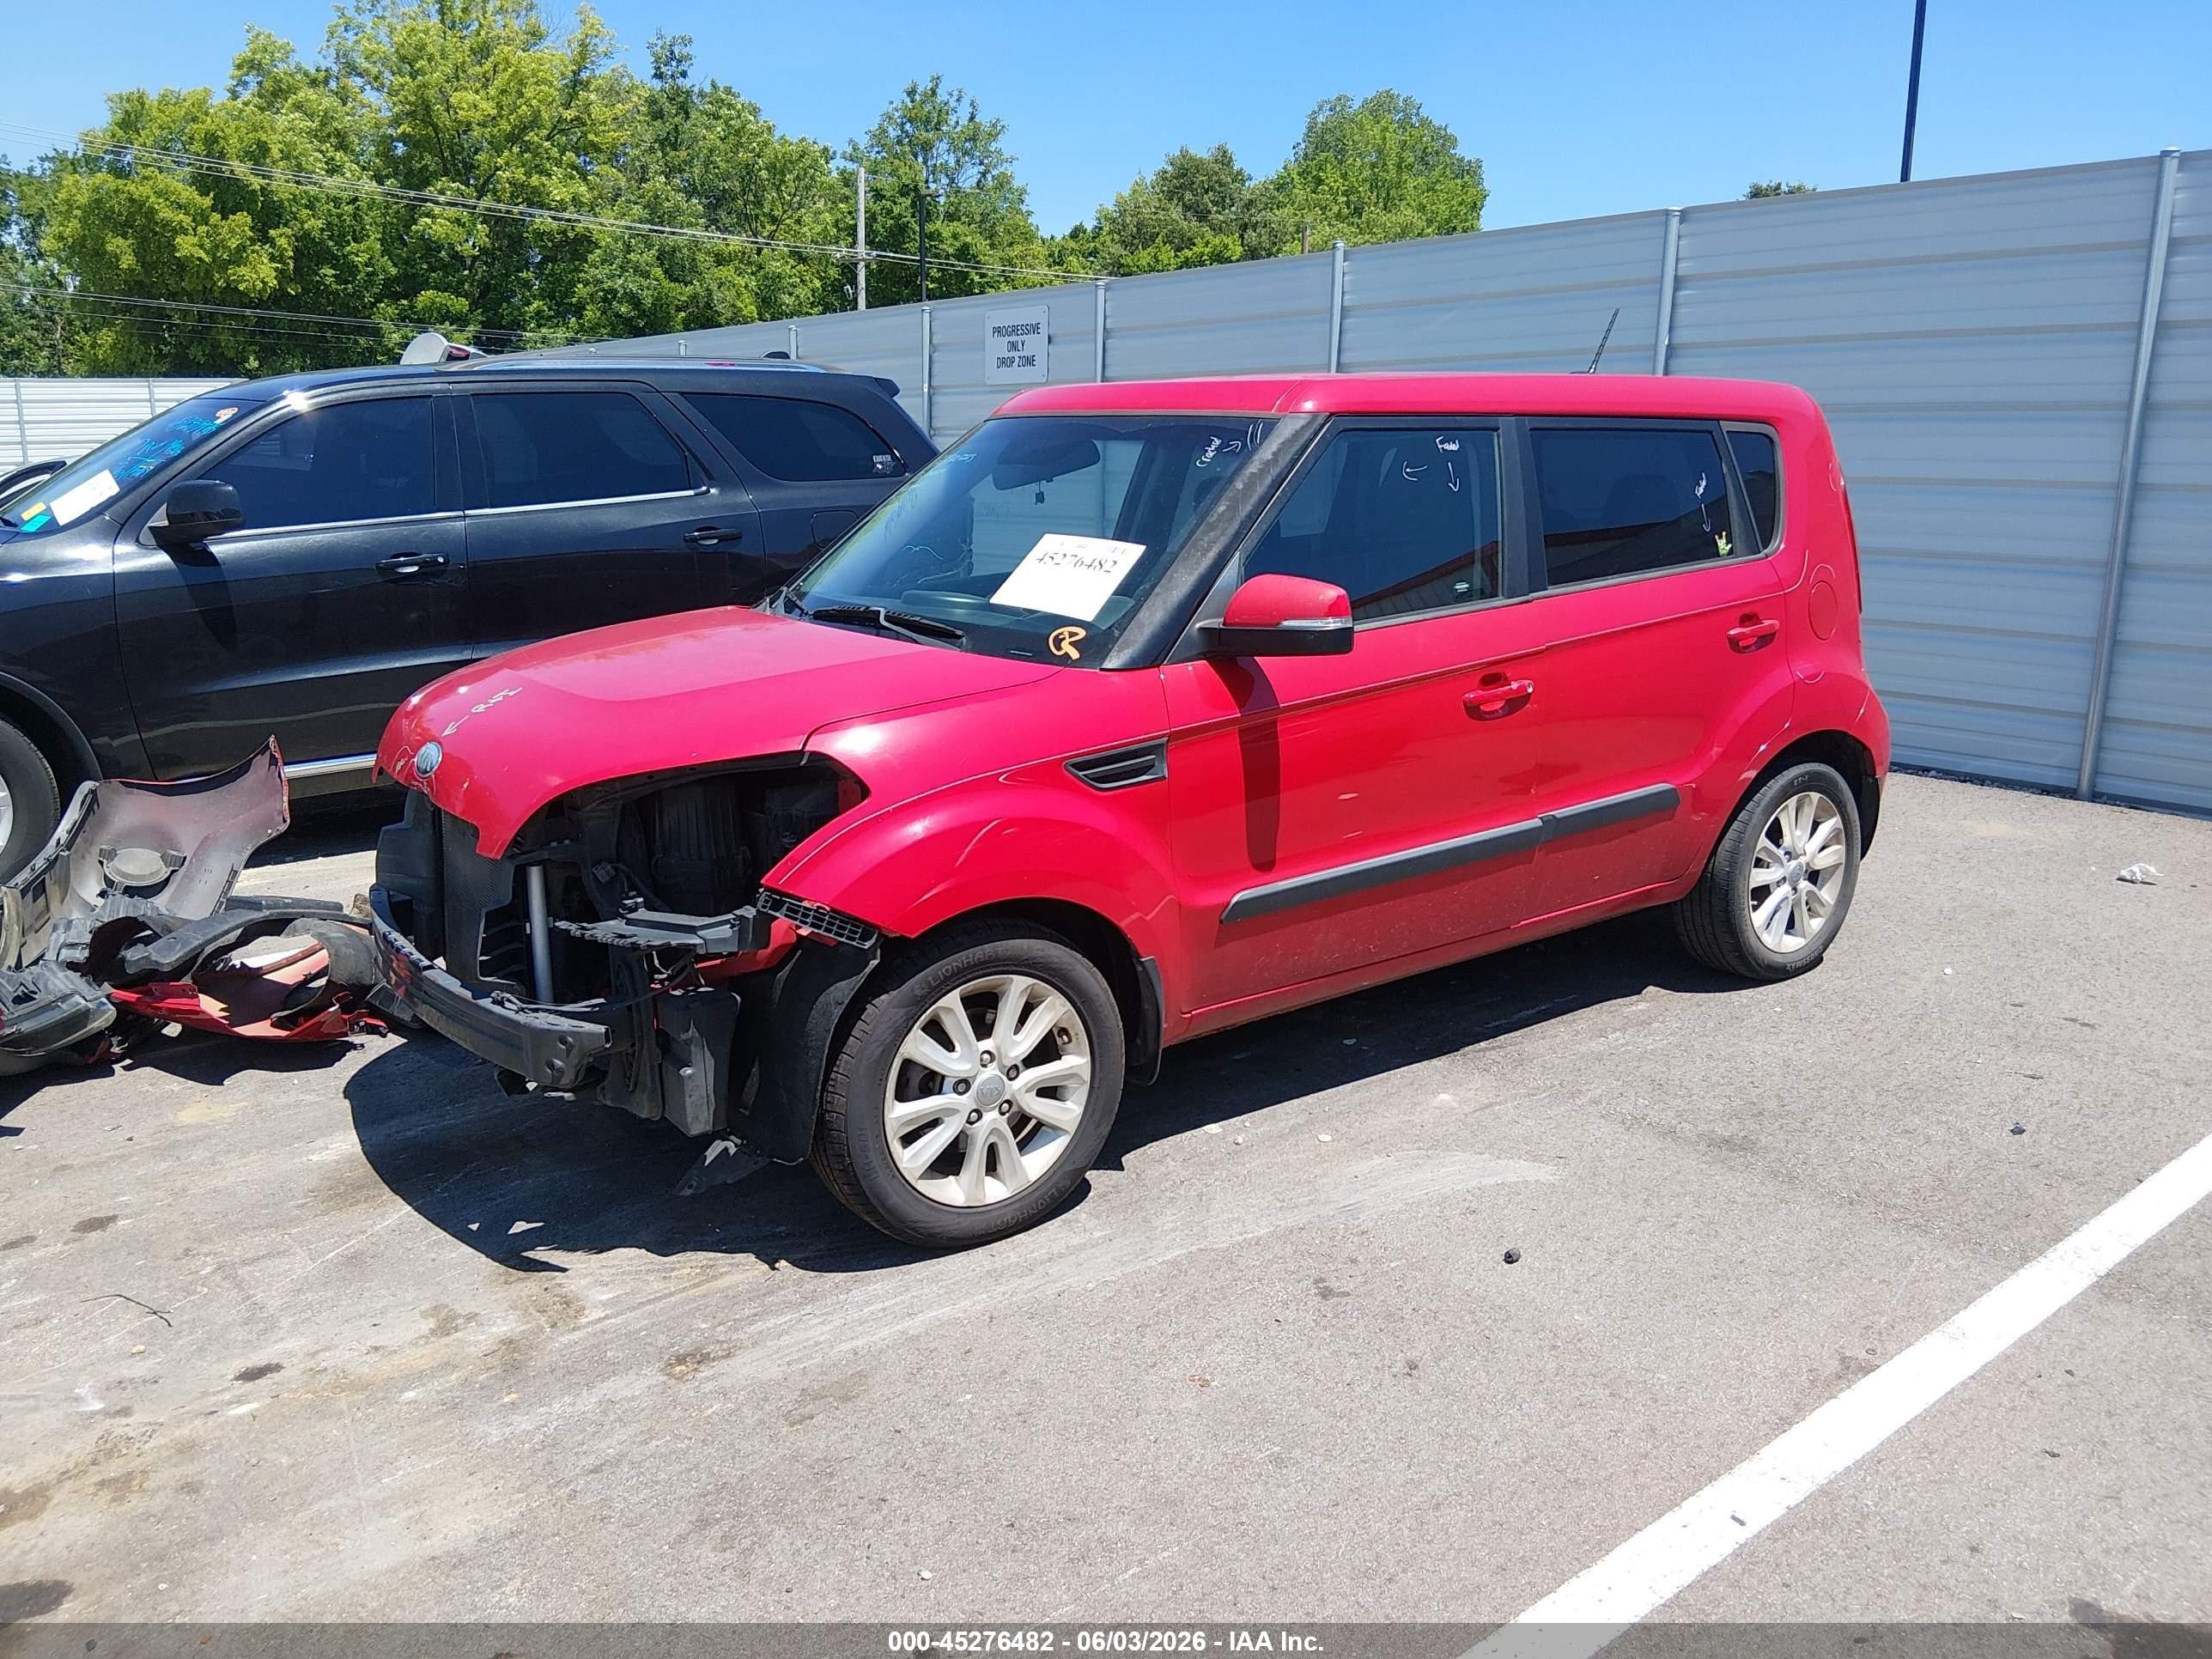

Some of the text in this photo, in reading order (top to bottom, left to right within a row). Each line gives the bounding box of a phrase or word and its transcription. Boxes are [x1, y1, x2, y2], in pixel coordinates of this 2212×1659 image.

[992, 322, 1041, 338] PROGRESSIVE
[1006, 339, 1025, 353] ONLY
[996, 354, 1036, 369] DROP ZONE
[1036, 551, 1118, 573] 45276482
